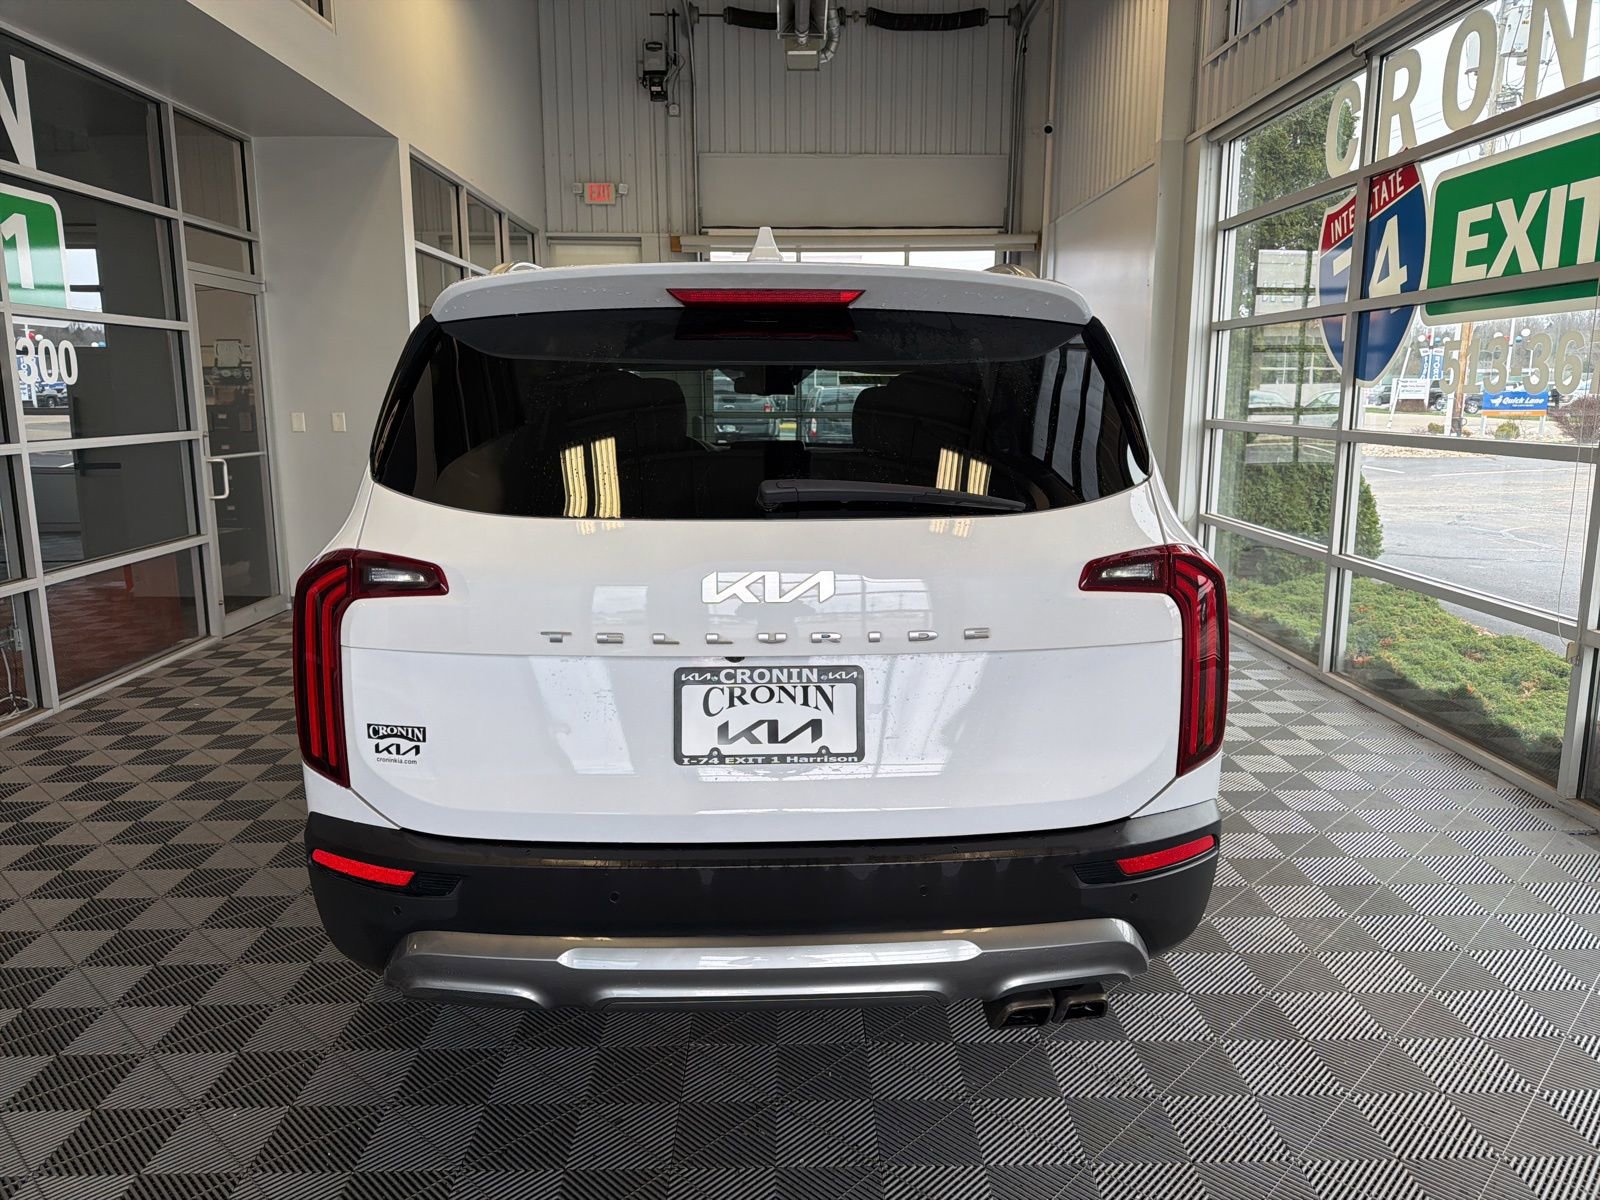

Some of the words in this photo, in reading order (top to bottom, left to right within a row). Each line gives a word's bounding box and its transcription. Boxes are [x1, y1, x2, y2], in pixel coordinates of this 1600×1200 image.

[590, 184, 610, 200] EXIT
[1330, 167, 1405, 244] INTETATE
[1451, 176, 1600, 284] EXIT
[1, 213, 35, 290] 1
[1502, 397, 1525, 405] Quick
[702, 571, 835, 604] KIA
[540, 627, 990, 645] TELLURIDE
[681, 672, 711, 681] KIA
[719, 668, 819, 684] CRONIN
[828, 671, 858, 679] KIA
[702, 685, 836, 718] CRONIN
[369, 725, 423, 741] CRONIN
[717, 718, 823, 745] KIA
[374, 742, 421, 756] KIA
[682, 757, 720, 765] I-74
[725, 756, 766, 765] EXIT
[770, 756, 780, 764] 1
[786, 755, 858, 763] Harrison
